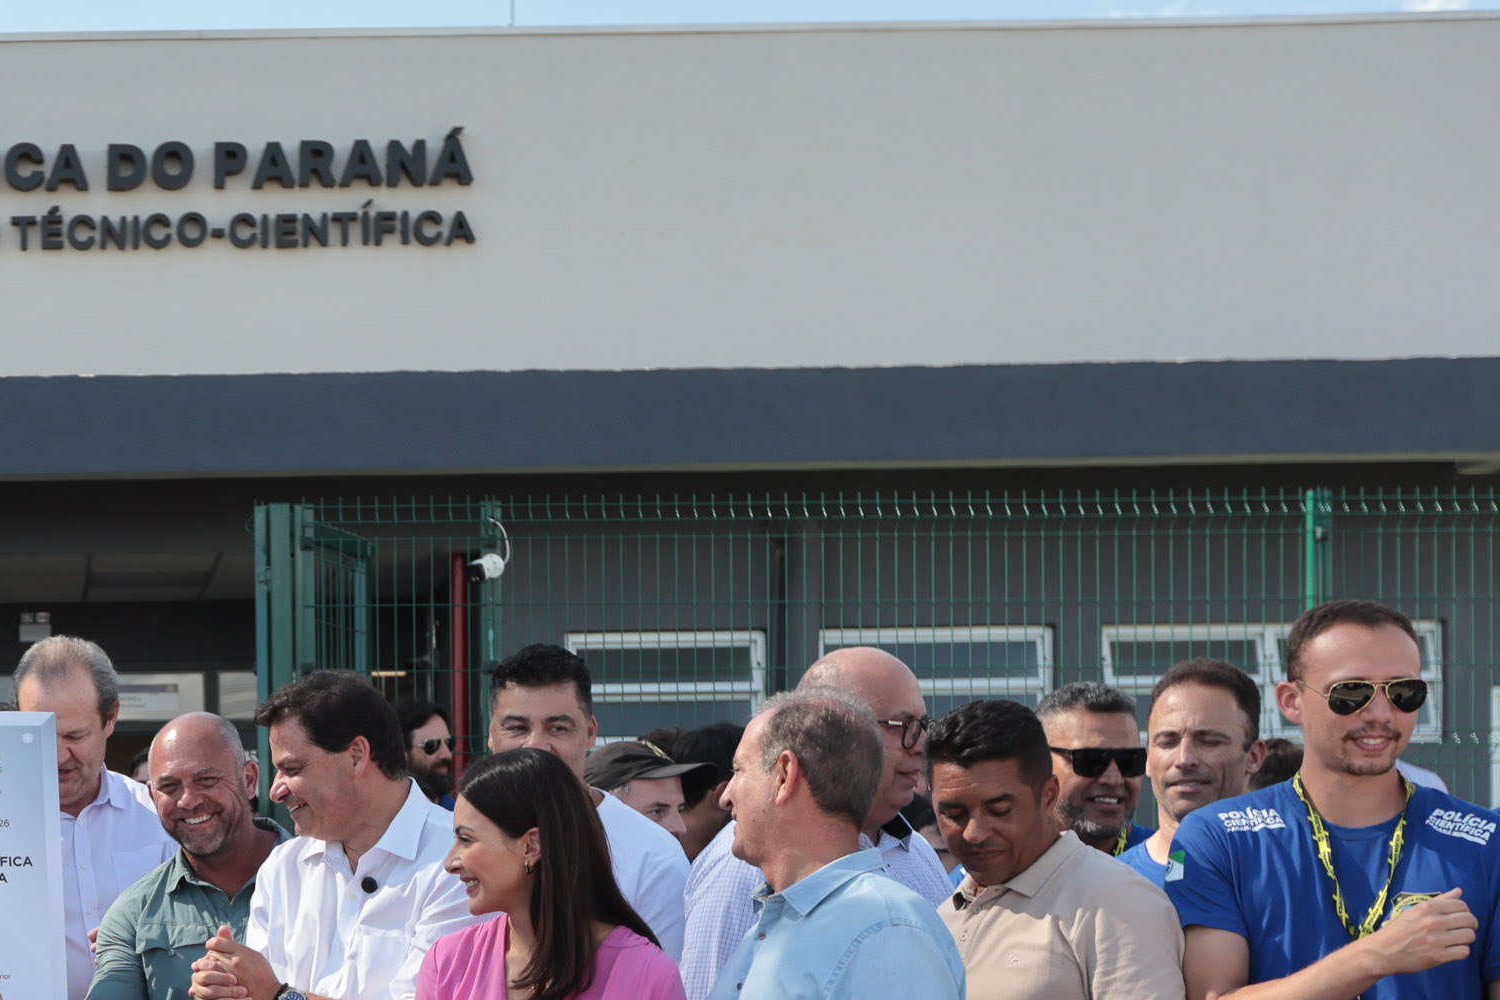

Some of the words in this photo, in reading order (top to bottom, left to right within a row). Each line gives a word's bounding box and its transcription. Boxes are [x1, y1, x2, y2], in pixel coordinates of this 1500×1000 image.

[107, 141, 195, 192] DO
[213, 126, 474, 190] PARANÁ
[11, 198, 476, 252] TÉCNICO-CIENTÍFICA
[1429, 815, 1491, 841] CIENTÍFICA
[1431, 808, 1497, 833] POLÍCIA
